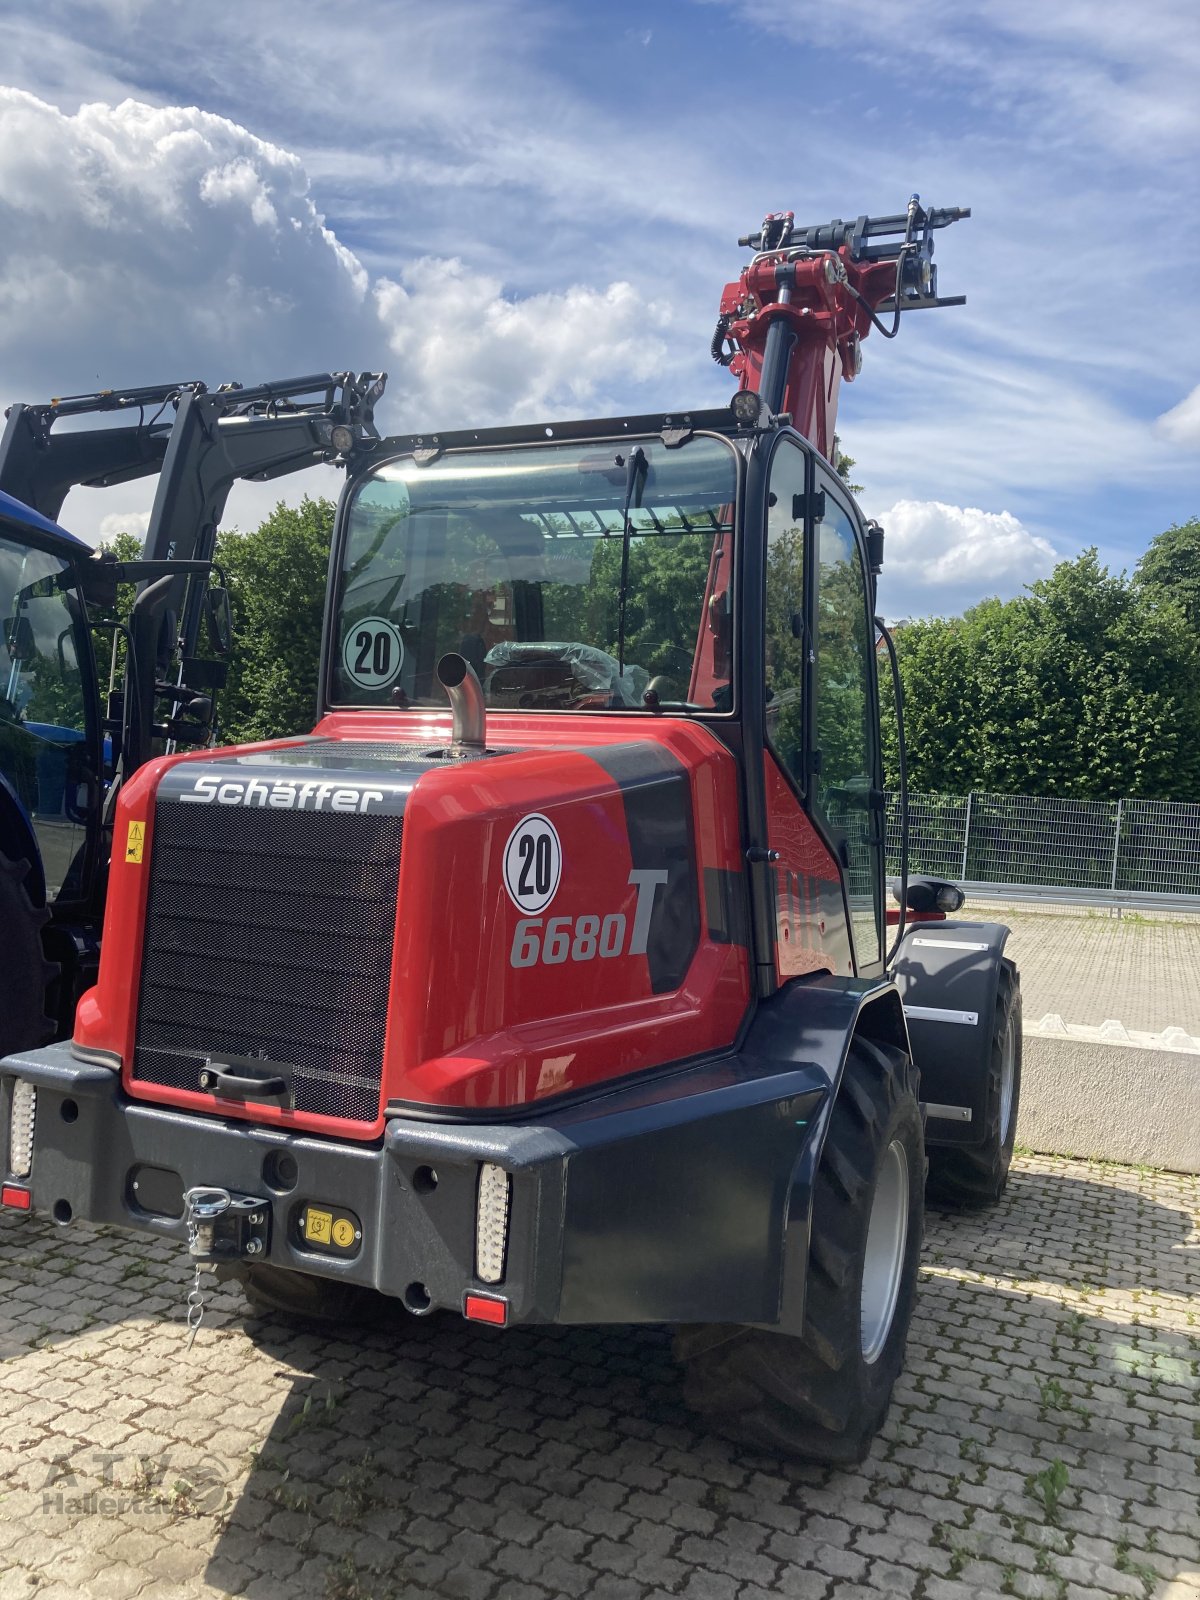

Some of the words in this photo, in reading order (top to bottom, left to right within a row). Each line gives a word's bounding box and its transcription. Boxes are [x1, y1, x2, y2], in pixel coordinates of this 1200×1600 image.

[354, 631, 391, 676] 20
[180, 776, 384, 813] Schäffer
[518, 833, 552, 896] 20
